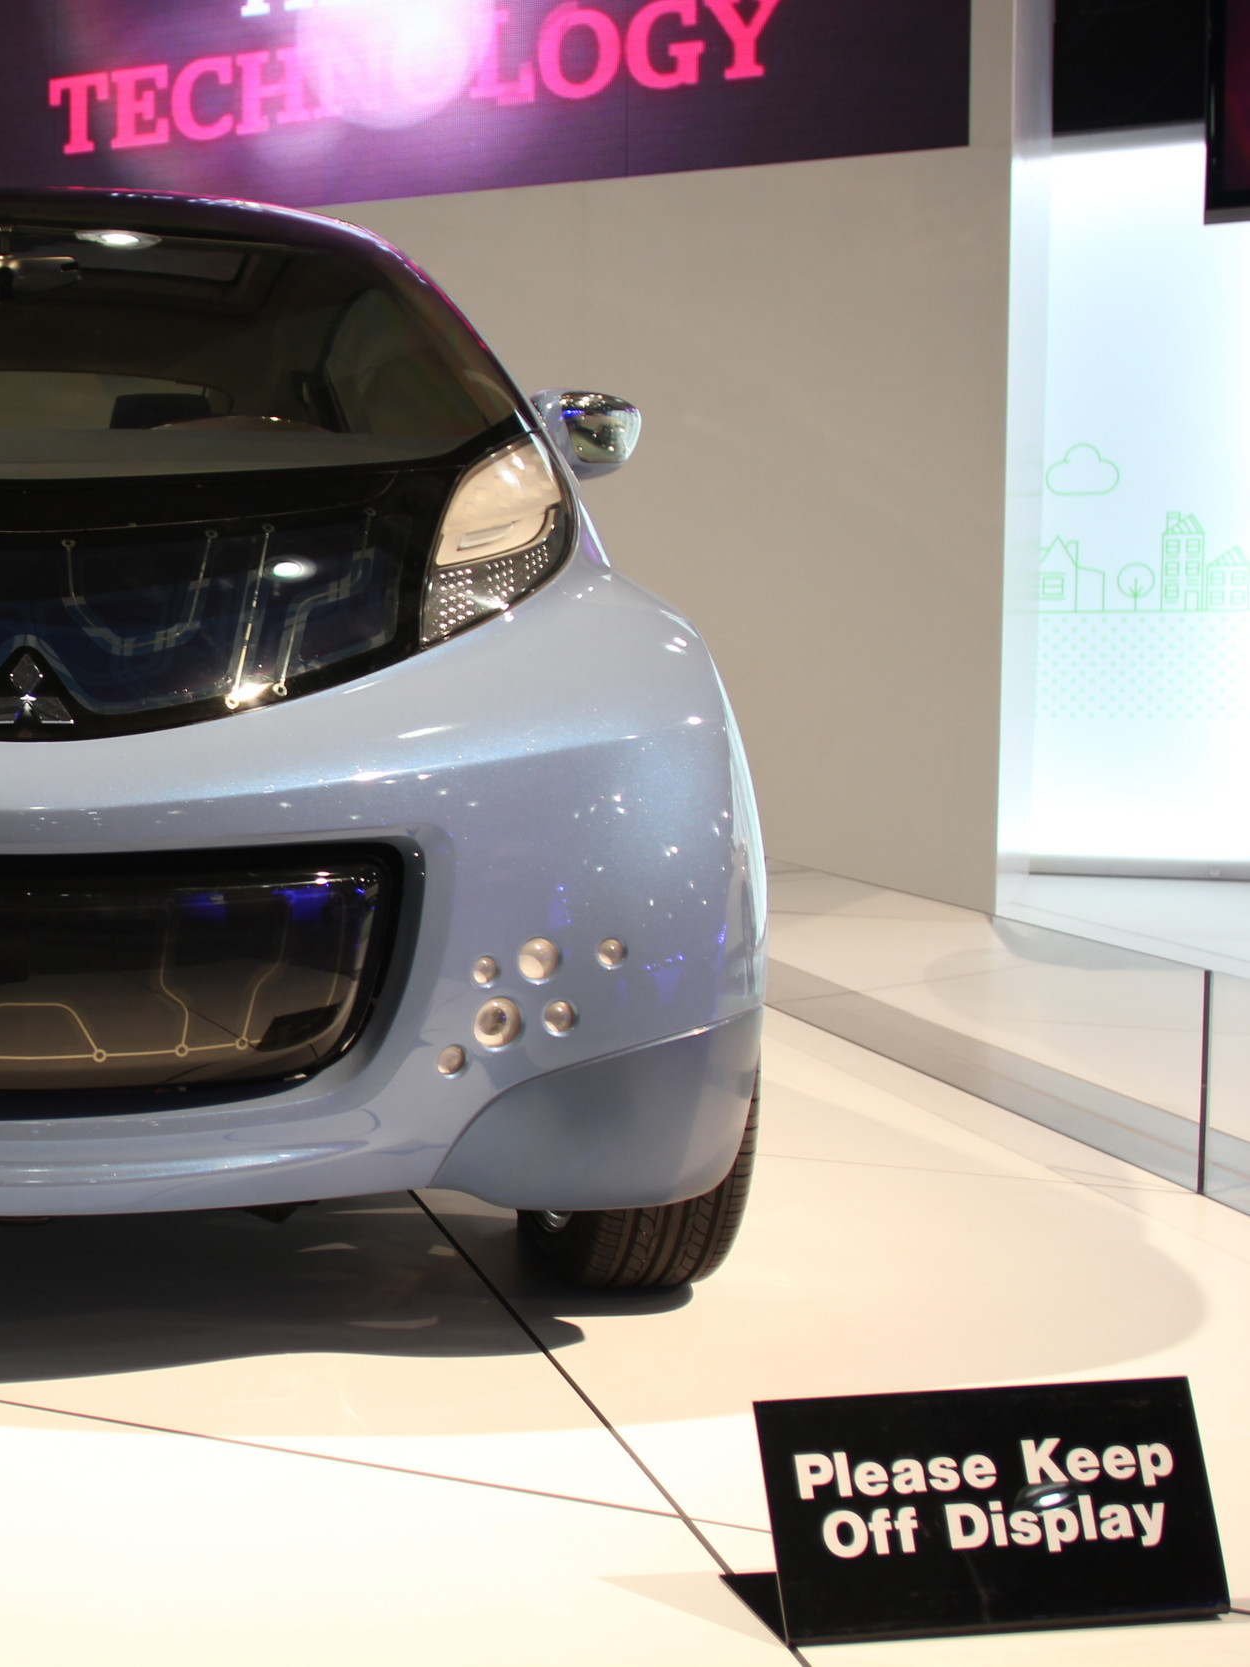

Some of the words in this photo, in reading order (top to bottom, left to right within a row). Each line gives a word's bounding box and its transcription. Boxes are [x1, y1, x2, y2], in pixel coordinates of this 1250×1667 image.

[793, 1450, 998, 1500] Please
[1020, 1437, 1175, 1487] Keep
[822, 1506, 919, 1559] Off
[944, 1494, 1166, 1553] Display
